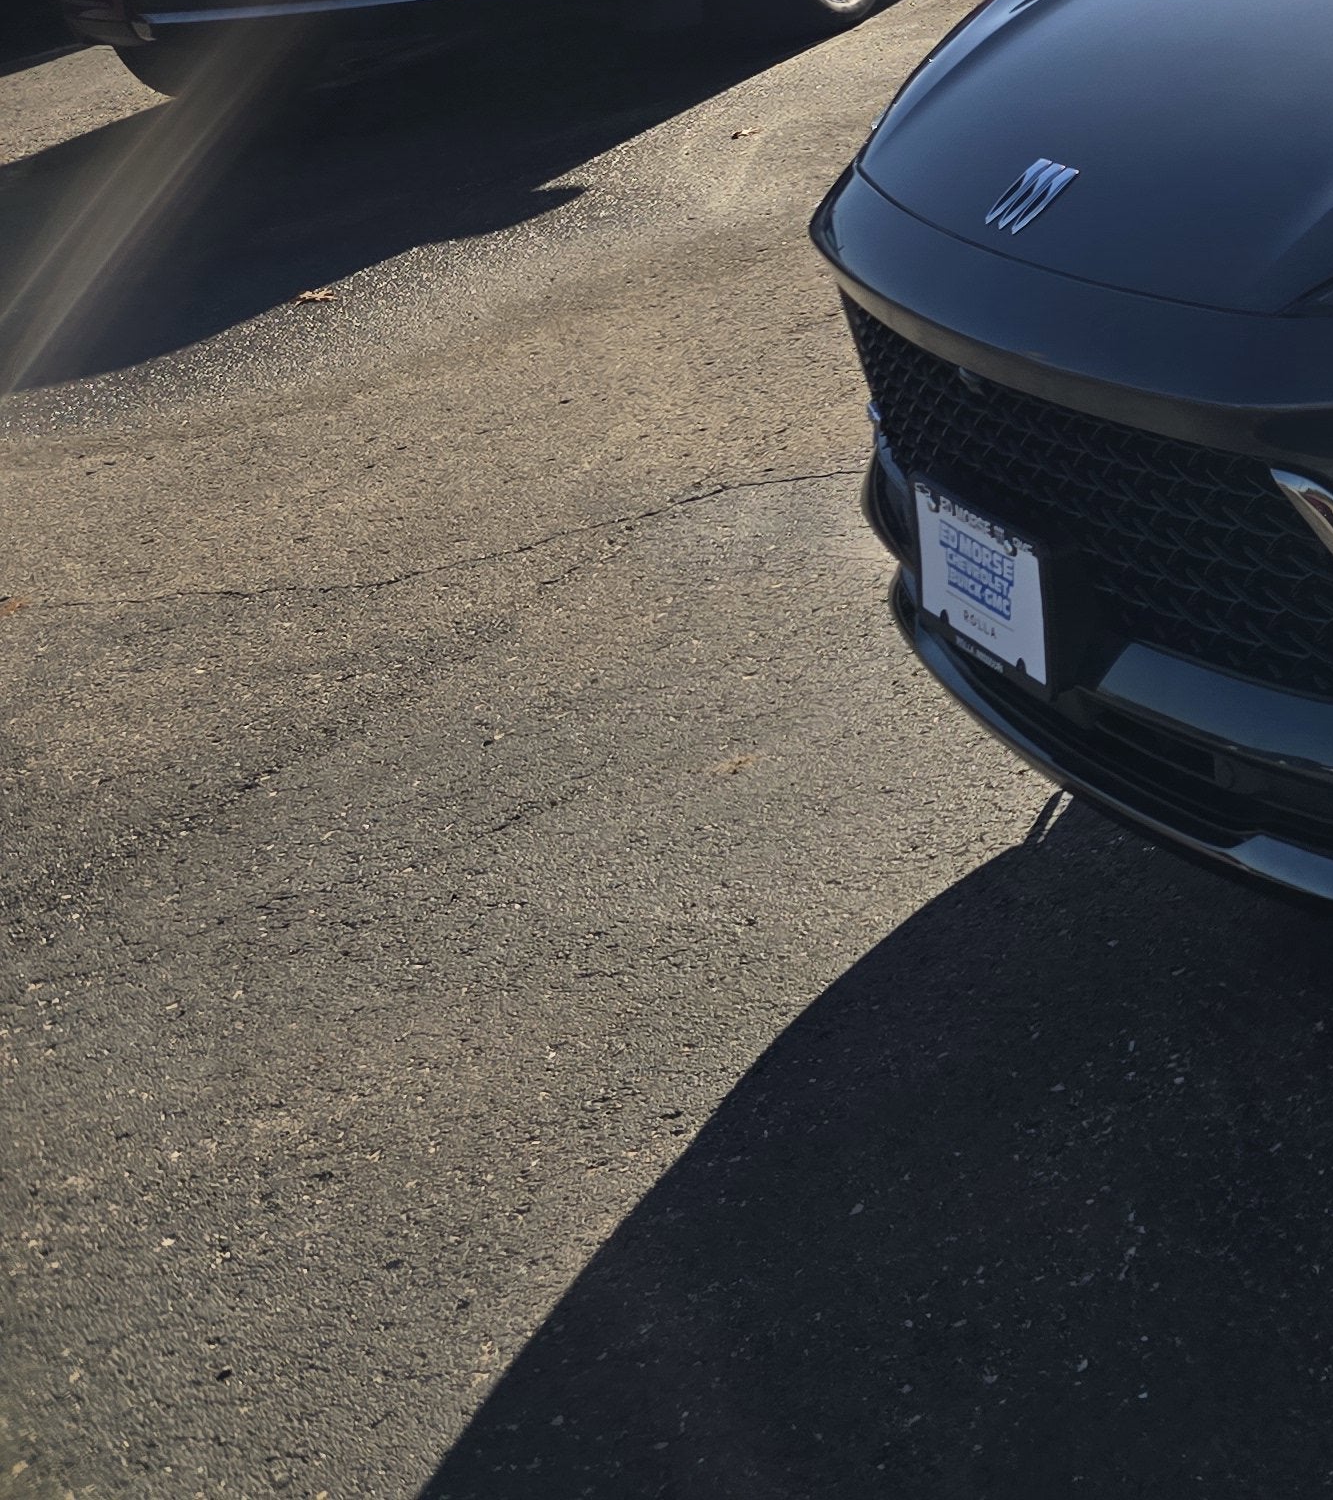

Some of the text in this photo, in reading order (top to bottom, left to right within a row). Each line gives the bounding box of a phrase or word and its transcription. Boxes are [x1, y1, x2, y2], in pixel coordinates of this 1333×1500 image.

[940, 520, 1013, 582] ED MORSE
[947, 548, 1008, 598] CHEVROLET
[949, 565, 1011, 617] BUICK GMC
